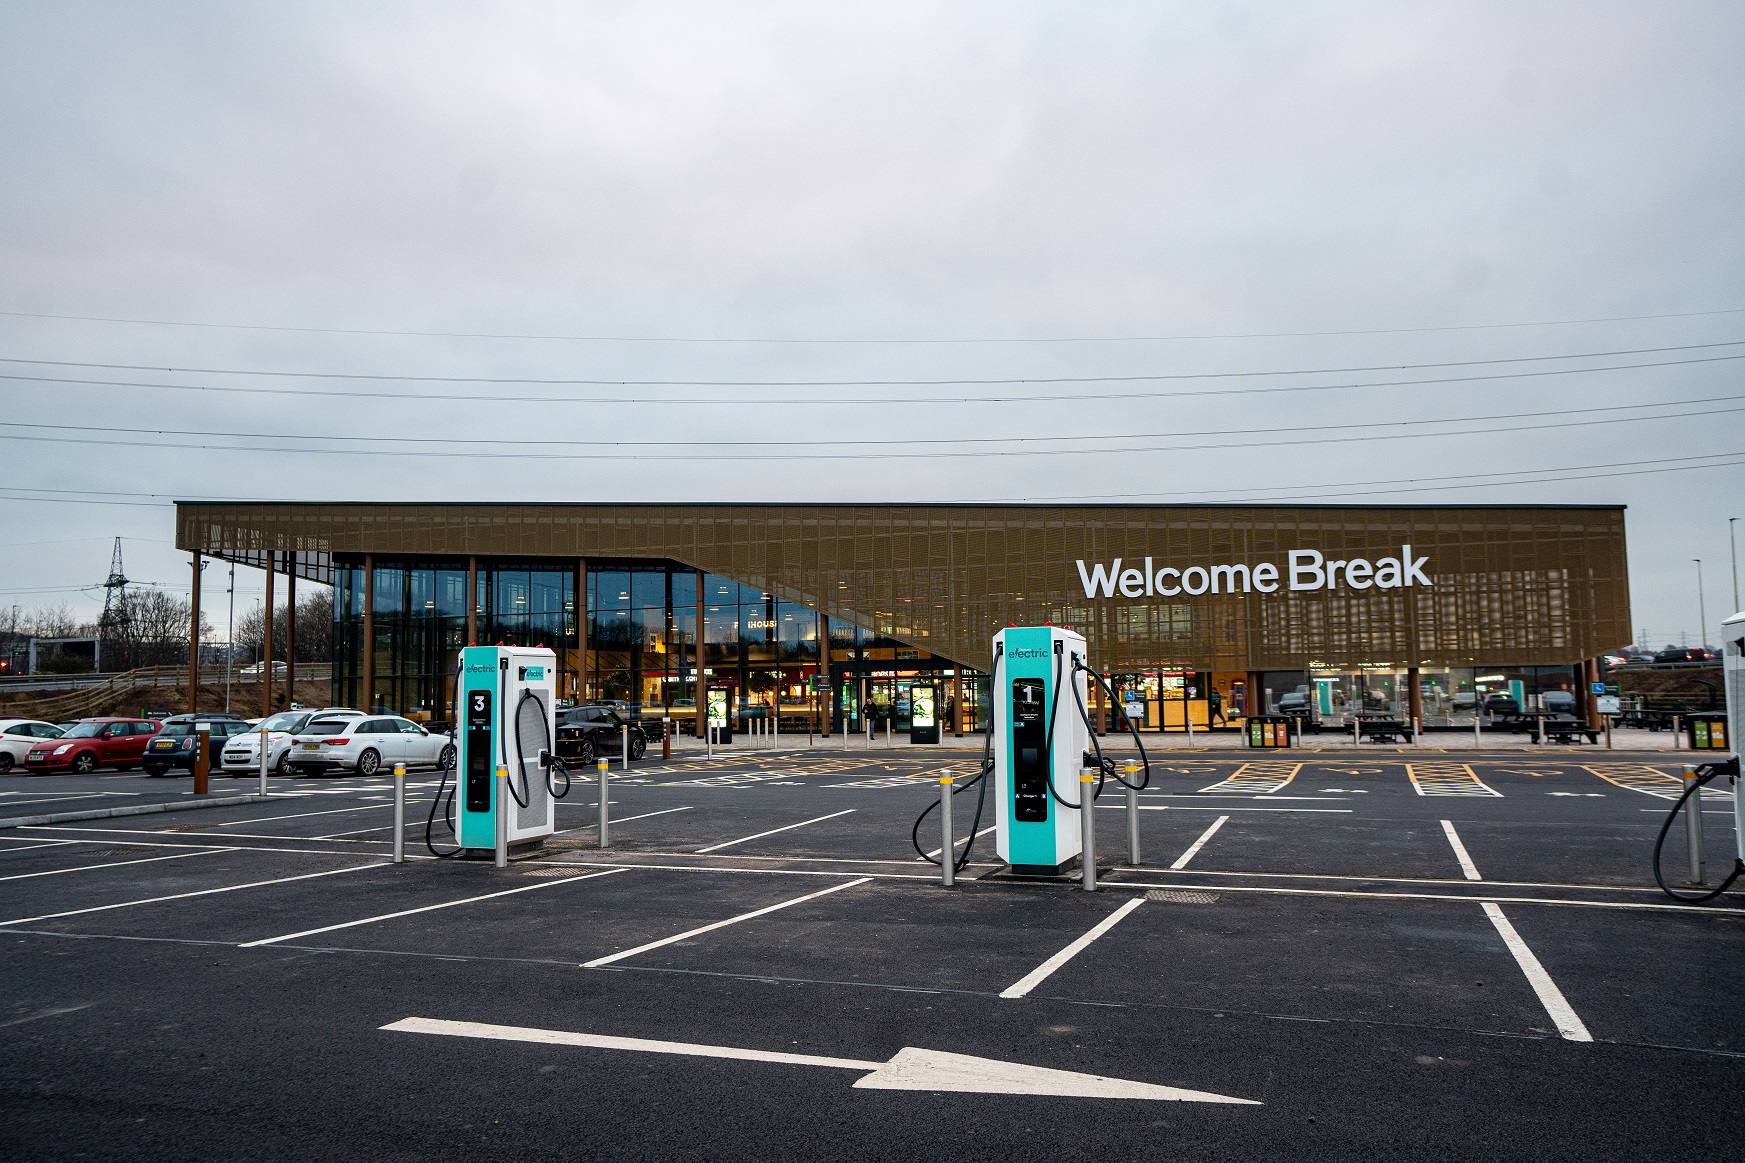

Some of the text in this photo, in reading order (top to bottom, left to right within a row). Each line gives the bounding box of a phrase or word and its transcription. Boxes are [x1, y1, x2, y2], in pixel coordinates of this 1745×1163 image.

[1076, 544, 1432, 598] Welcome Break
[1008, 648, 1048, 659] electric
[466, 664, 496, 673] electric
[1023, 685, 1032, 702] 1
[474, 695, 485, 712] 3
